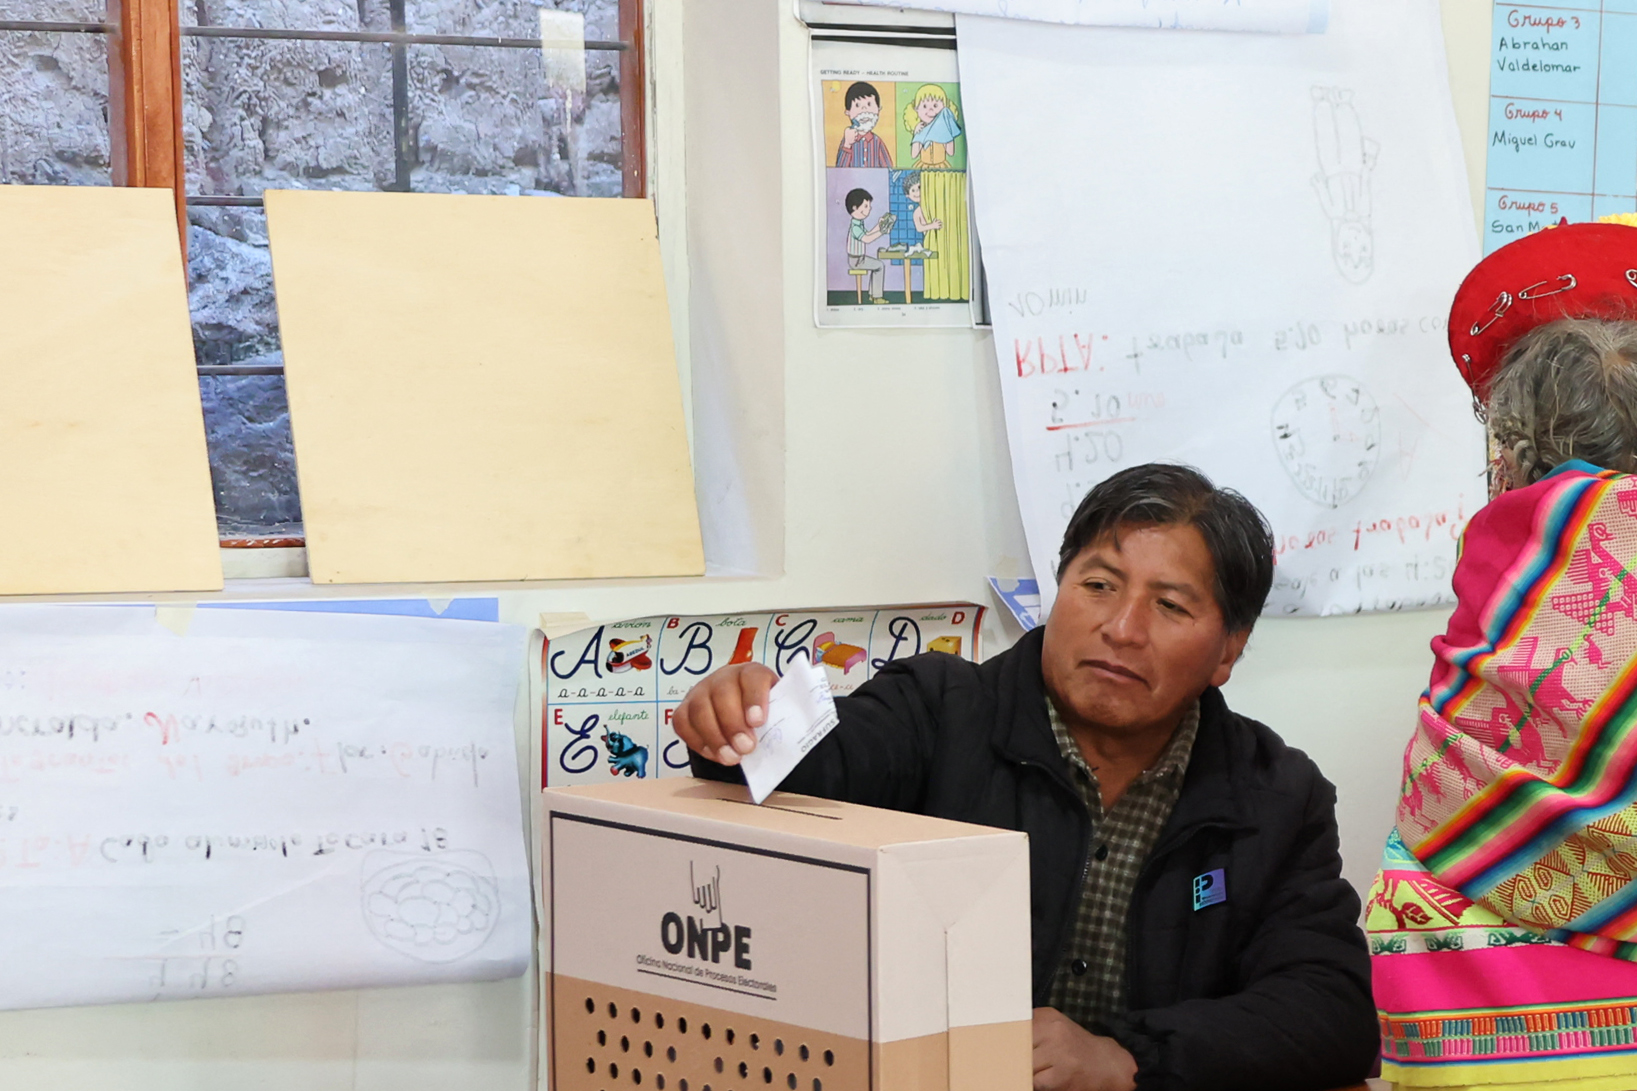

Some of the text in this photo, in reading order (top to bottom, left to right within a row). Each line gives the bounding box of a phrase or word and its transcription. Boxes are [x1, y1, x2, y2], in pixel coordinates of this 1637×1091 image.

[1507, 10, 1581, 33] Grupo 3
[1499, 37, 1568, 51] Abrahan
[1497, 57, 1581, 73] Valdelomar
[1505, 103, 1563, 123] Grupo 4
[1492, 130, 1537, 152] Miguel
[1498, 195, 1559, 216] Grupo 5
[1491, 220, 1523, 233] San
[667, 617, 747, 629] B bota
[775, 614, 789, 626] C
[919, 611, 965, 625] dado D
[551, 625, 602, 679] A
[660, 622, 712, 675] B
[554, 709, 649, 725] E elefante
[665, 709, 673, 725] F
[560, 714, 599, 773] E
[801, 719, 836, 753] SUFRAGIO
[661, 912, 752, 970] ONPE
[636, 954, 777, 992] Oficina Nacional de Procesos Electorales
